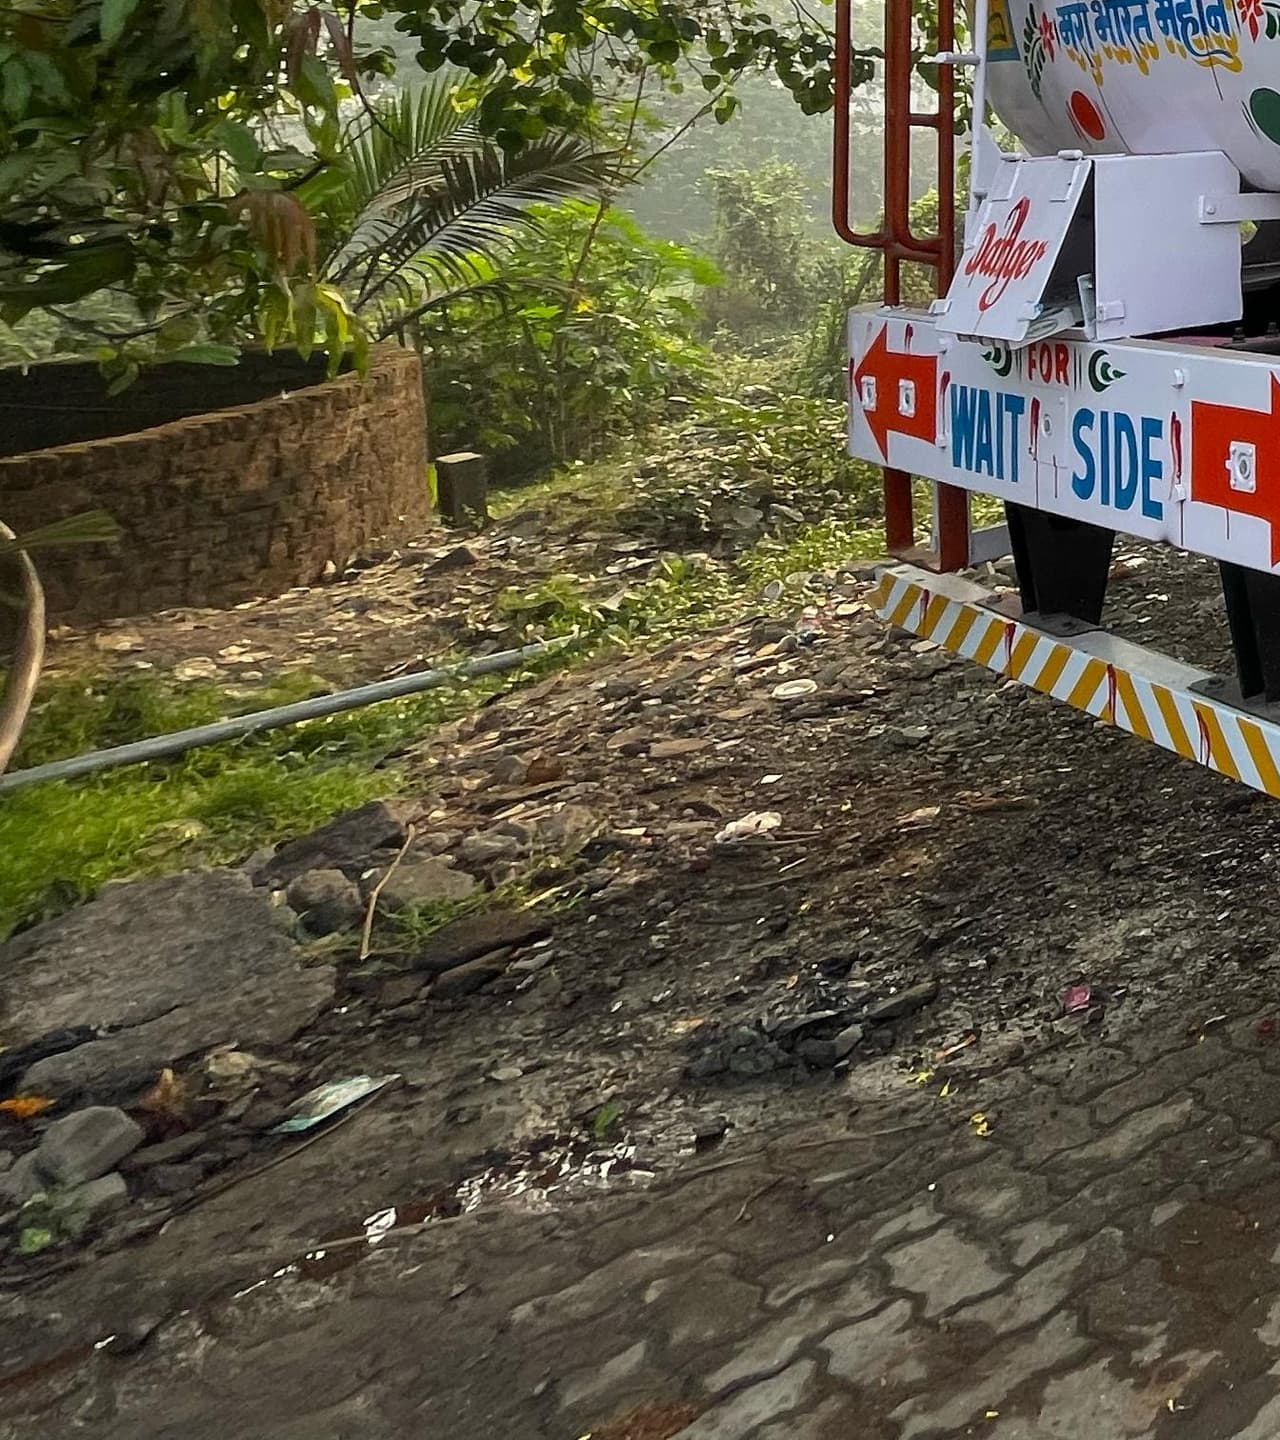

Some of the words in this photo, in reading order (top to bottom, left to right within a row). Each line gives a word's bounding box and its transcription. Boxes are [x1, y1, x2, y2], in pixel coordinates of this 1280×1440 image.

[1028, 343, 1069, 386] FOR
[950, 384, 1025, 484] WAIT
[1071, 408, 1163, 521] SIDE
